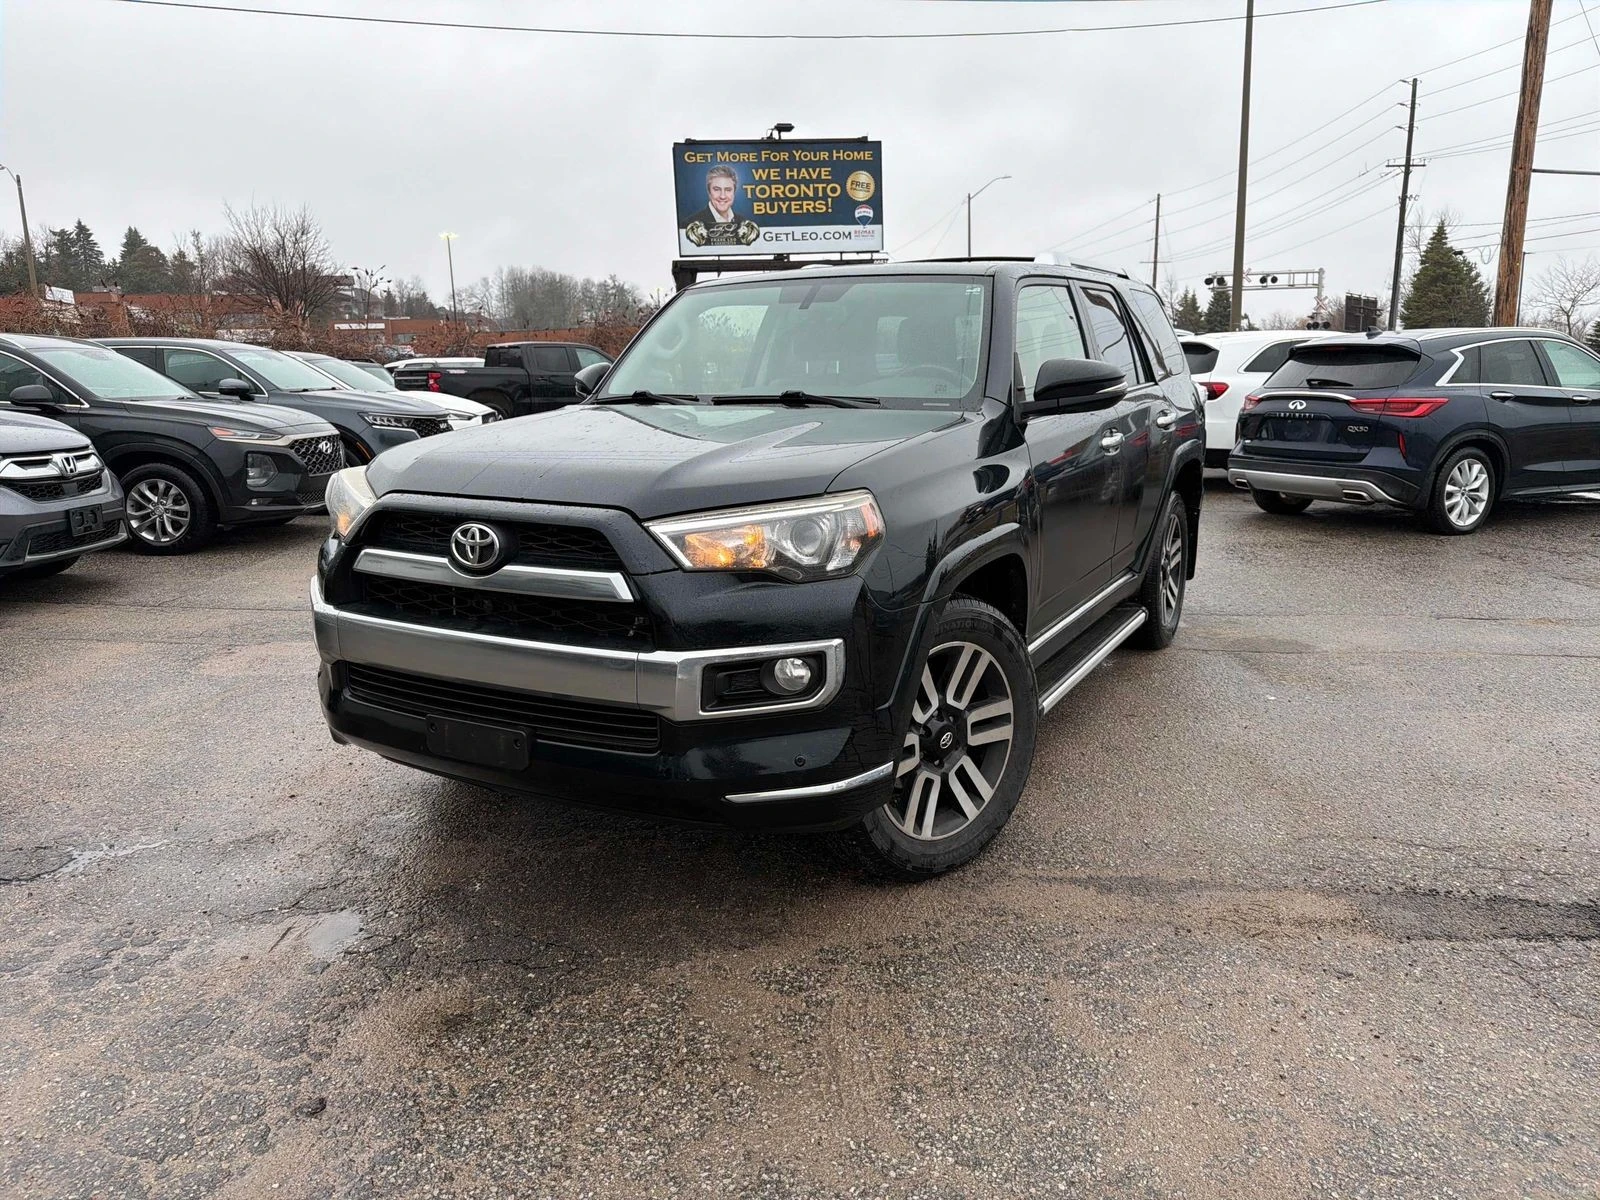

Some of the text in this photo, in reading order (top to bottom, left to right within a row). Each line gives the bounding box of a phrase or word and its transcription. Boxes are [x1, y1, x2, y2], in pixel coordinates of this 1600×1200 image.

[684, 149, 873, 163] GET MORE FOR YOUR HOME
[752, 168, 832, 181] WE HAVE
[743, 183, 841, 199] TORONTO
[850, 180, 872, 190] FREE
[753, 198, 832, 215] BUYERS!
